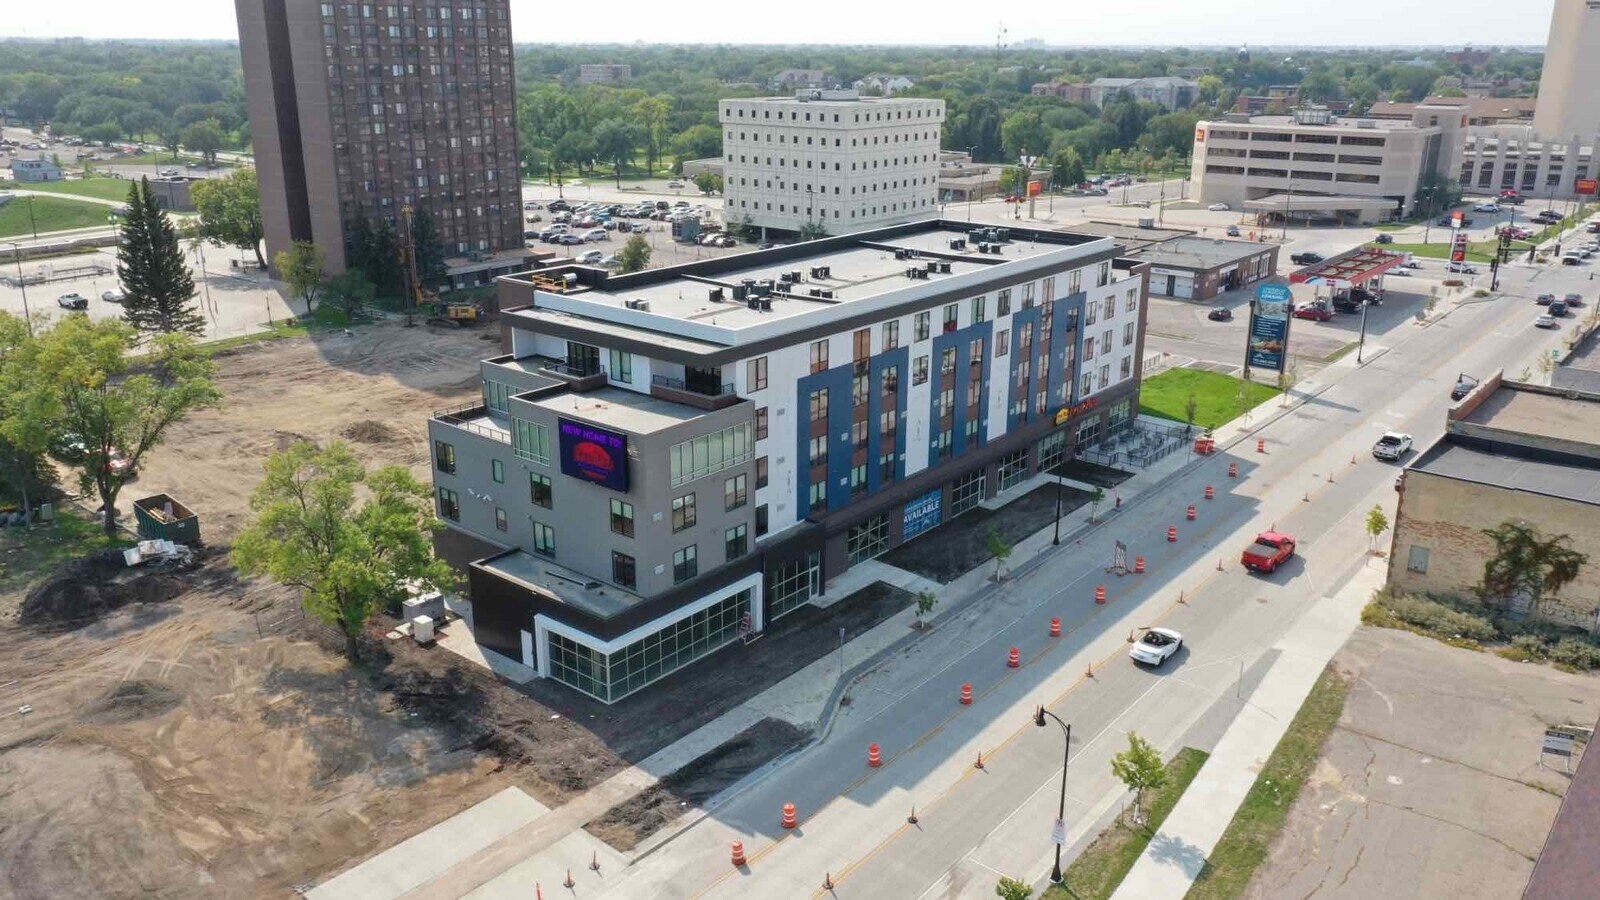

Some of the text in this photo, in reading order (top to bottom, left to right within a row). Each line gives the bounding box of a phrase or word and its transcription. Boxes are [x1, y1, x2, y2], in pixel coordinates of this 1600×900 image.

[562, 423, 581, 437] NEW
[583, 429, 607, 444] HOME
[903, 500, 940, 523] AVAILABLE
